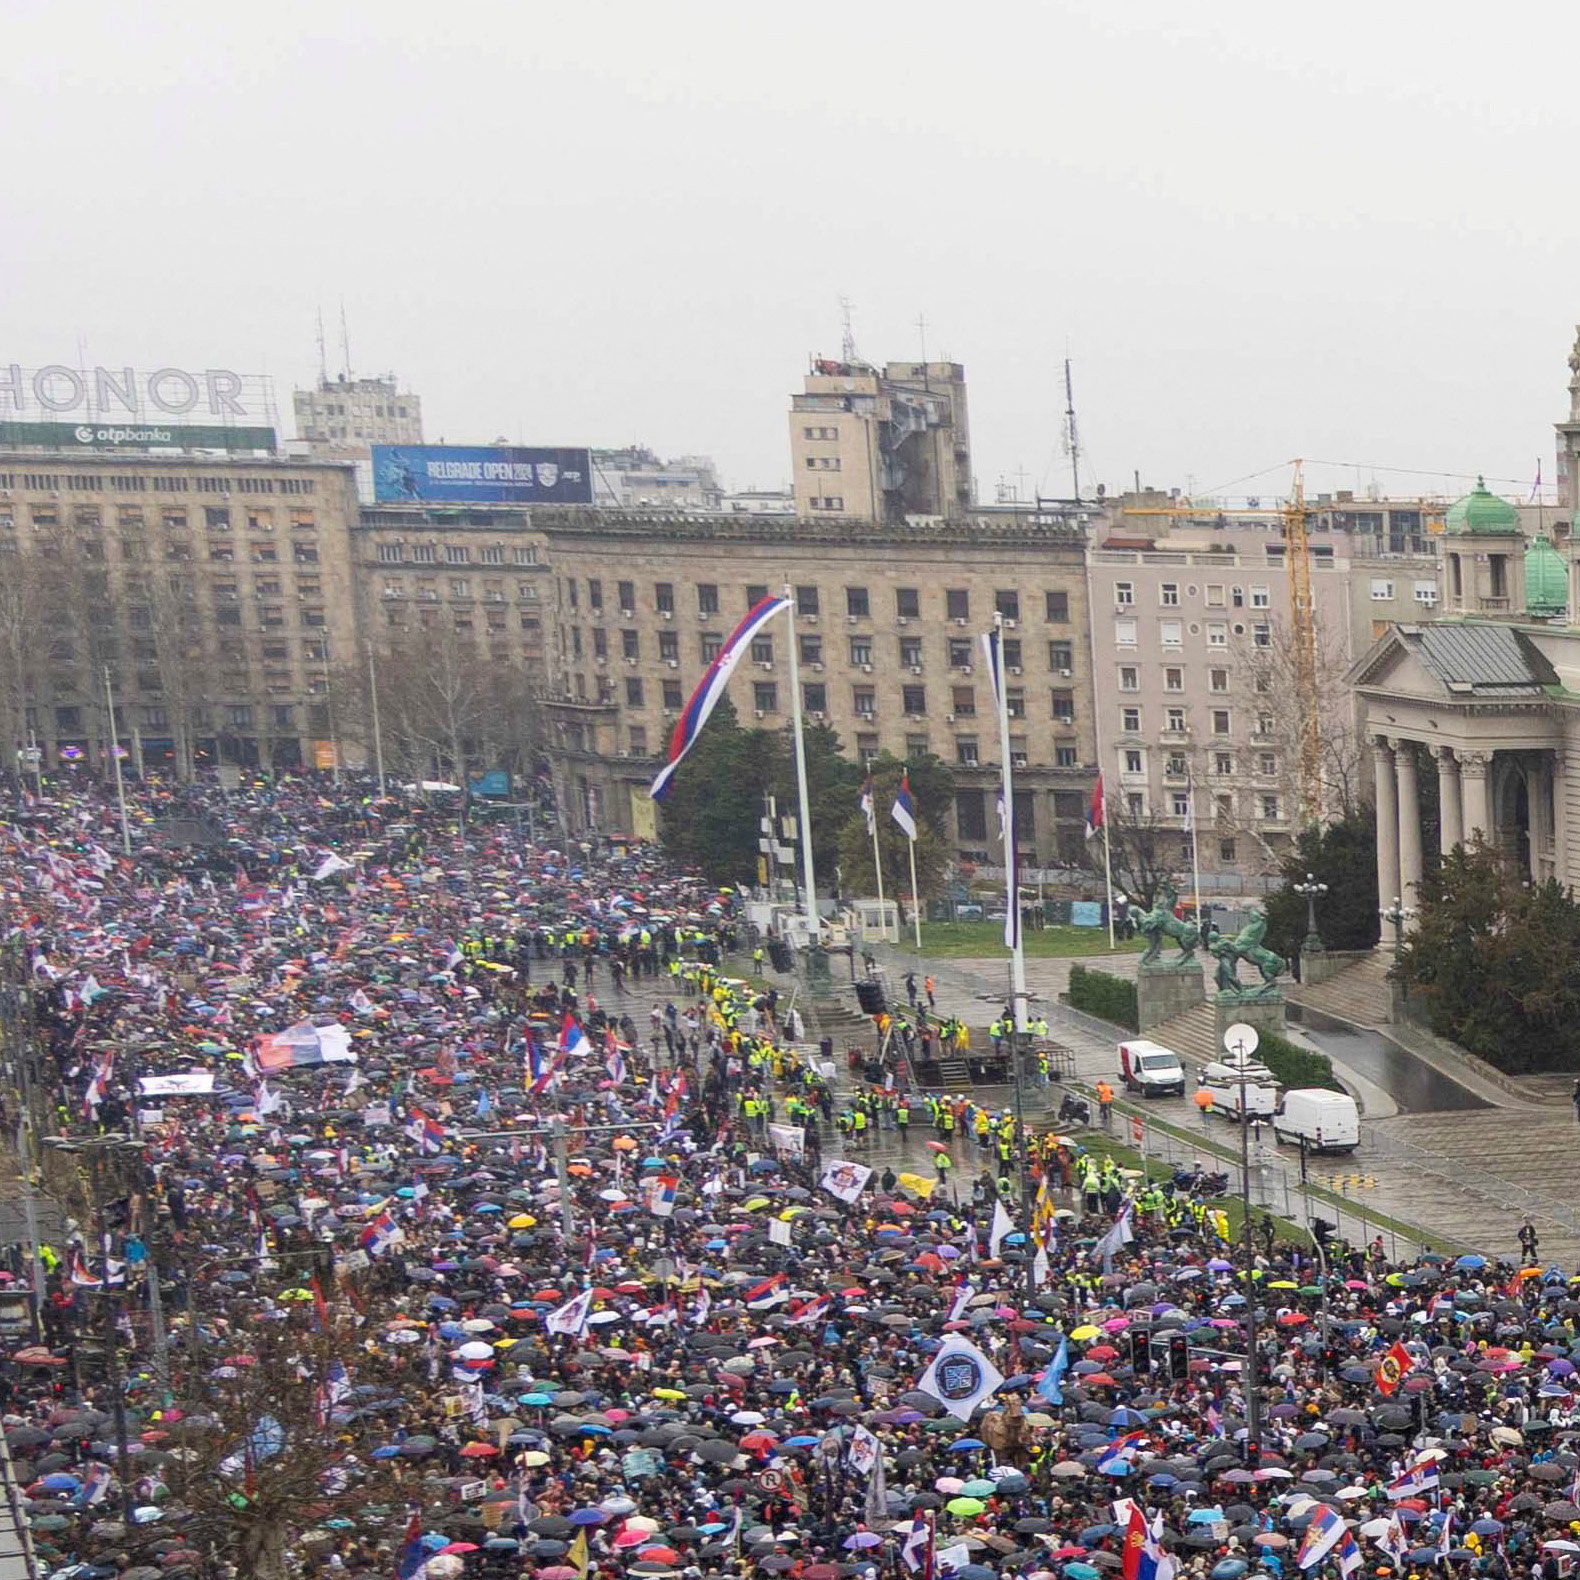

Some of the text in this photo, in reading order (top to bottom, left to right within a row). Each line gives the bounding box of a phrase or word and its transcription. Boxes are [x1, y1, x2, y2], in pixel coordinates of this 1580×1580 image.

[0, 364, 247, 416] HONOR
[426, 460, 483, 479] BELGRADE
[483, 461, 514, 480] OPEN
